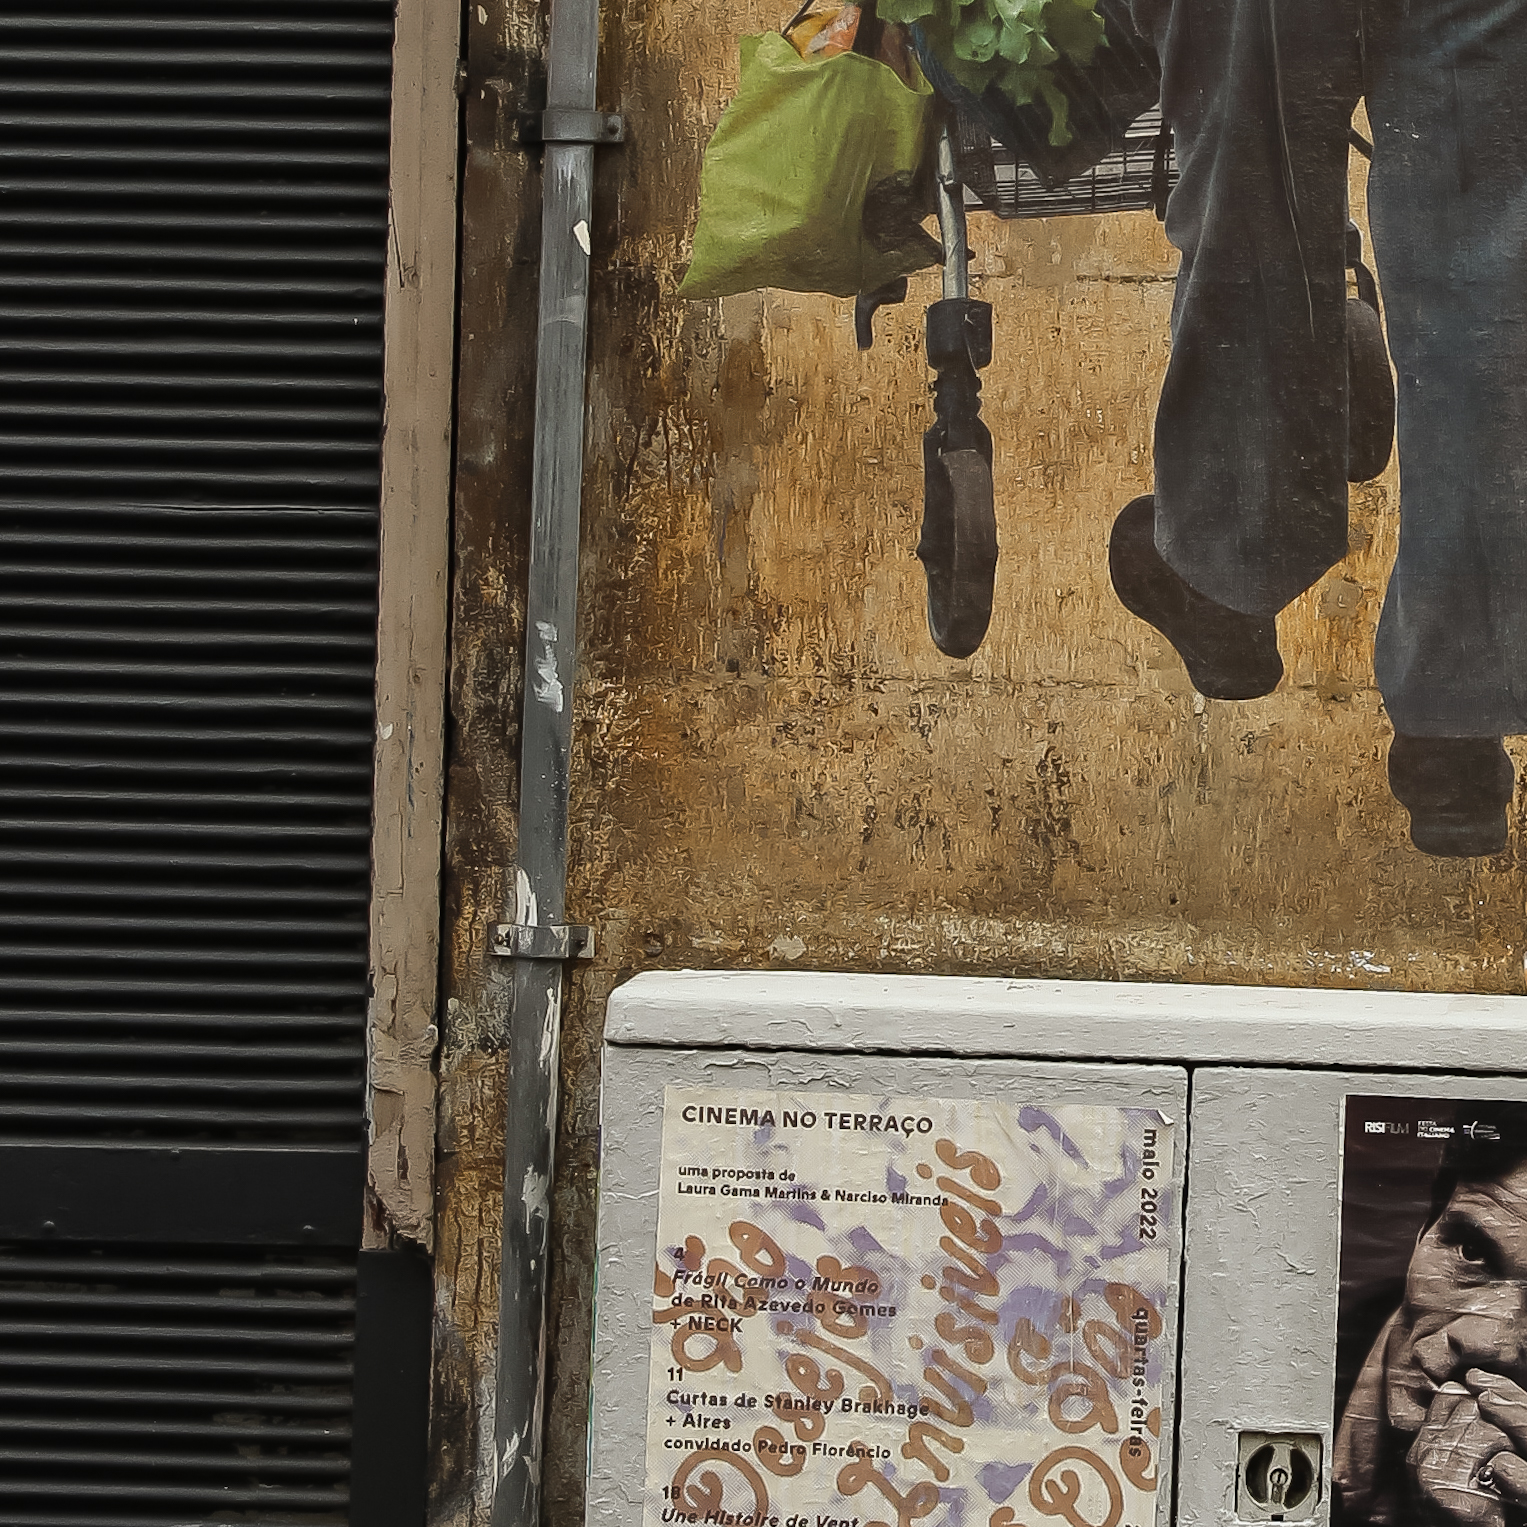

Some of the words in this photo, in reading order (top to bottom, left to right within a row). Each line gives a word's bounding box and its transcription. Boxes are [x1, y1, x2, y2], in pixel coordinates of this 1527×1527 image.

[681, 1105, 776, 1127] CINEMA
[782, 1111, 817, 1128] NO
[823, 1112, 934, 1138] TERRAÇO
[1141, 1128, 1160, 1180] maio
[678, 1165, 709, 1177] uma
[711, 1167, 776, 1181] proposta
[778, 1169, 796, 1182] de
[677, 1182, 717, 1196] Laura
[720, 1184, 761, 1198] Gama
[764, 1186, 817, 1201] Martins
[820, 1188, 831, 1202] &
[835, 1190, 888, 1204] Narciso
[891, 1192, 949, 1207] Miranda
[1139, 1187, 1158, 1241] 2022
[673, 1246, 685, 1262] 4
[672, 1270, 729, 1290] Frágil
[734, 1274, 789, 1290] Como
[794, 1279, 806, 1291] o
[811, 1276, 881, 1295] Mundo
[671, 1292, 695, 1308] de
[701, 1294, 738, 1311] Rita
[743, 1296, 827, 1315] Azevedo
[832, 1300, 897, 1318] Gomes
[688, 1316, 744, 1333] NECK
[667, 1366, 685, 1382] 11
[1128, 1307, 1150, 1459] quartas-feiras
[666, 1389, 728, 1408] Curtas
[734, 1392, 758, 1408] de
[763, 1393, 835, 1415] Stanley
[840, 1397, 930, 1420] Brakhage
[682, 1413, 732, 1430] Aires
[664, 1436, 751, 1454] convidado
[757, 1439, 807, 1456] Pedro
[812, 1442, 892, 1460] Florêncio
[662, 1485, 680, 1501] 18
[661, 1507, 700, 1526] Une
[703, 1509, 779, 1527] Histoire
